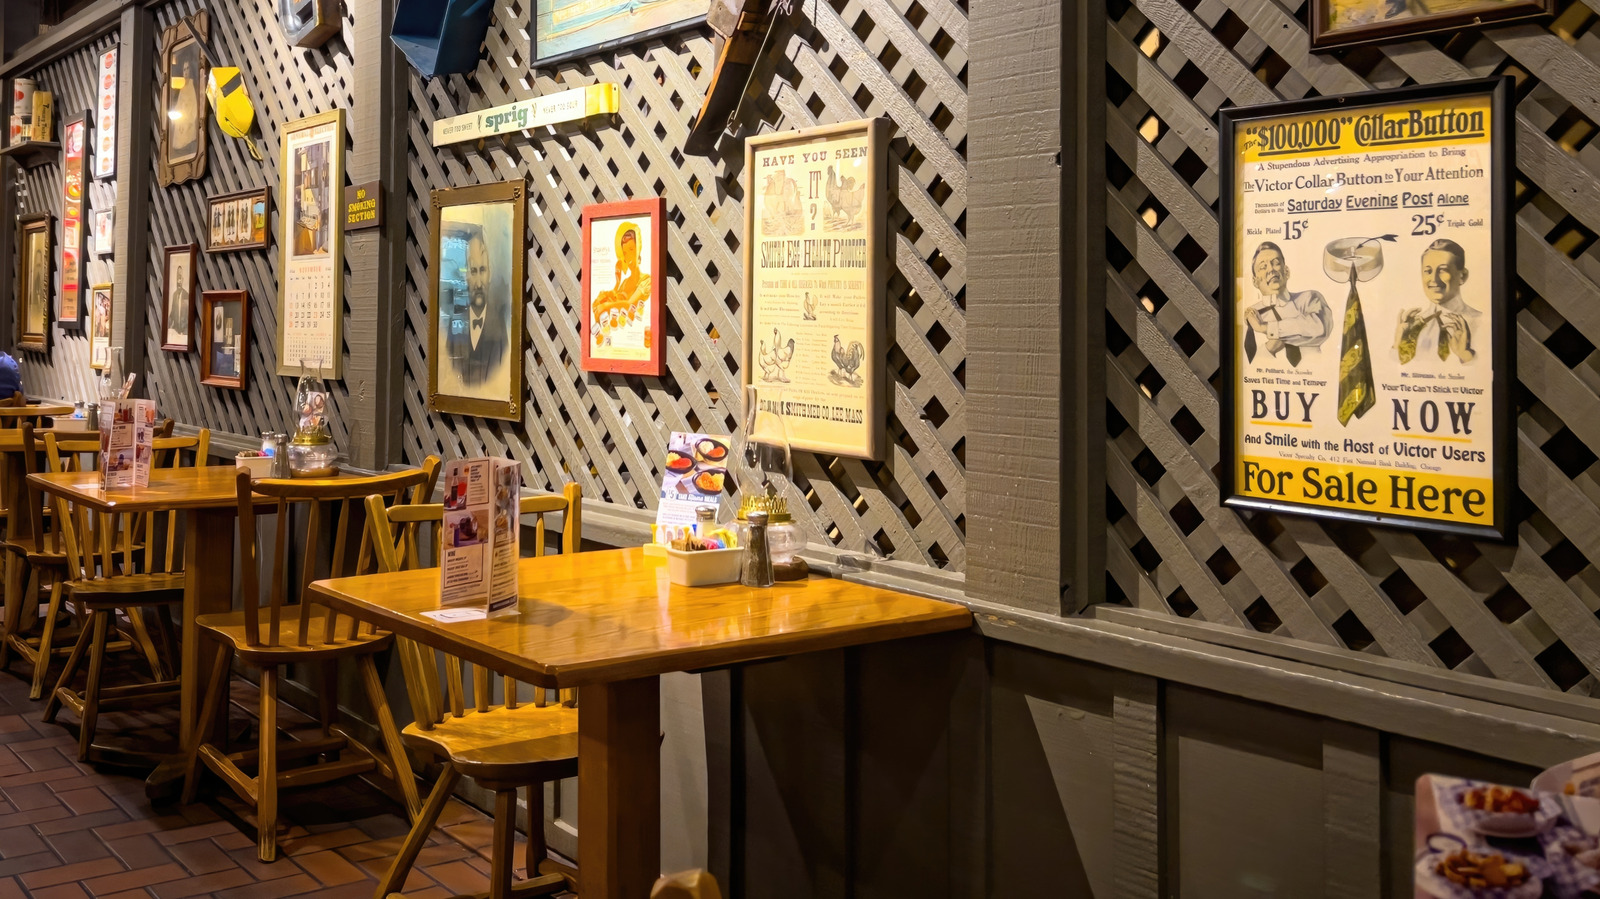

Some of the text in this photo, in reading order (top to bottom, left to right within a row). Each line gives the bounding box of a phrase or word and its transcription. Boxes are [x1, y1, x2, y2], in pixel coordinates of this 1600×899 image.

[485, 106, 528, 132] sprig
[1354, 114, 1408, 146] Collar
[1408, 108, 1484, 136] Button
[762, 146, 868, 167] HAVE YOU SEEN
[1258, 163, 1264, 171] A
[1267, 160, 1310, 171] Stupendous
[1314, 156, 1360, 166] Advertising
[1364, 150, 1426, 163] Appropriation
[1442, 147, 1466, 157] Bring
[808, 170, 822, 200] IT
[1244, 181, 1254, 190] The
[1254, 178, 1293, 192] Victor
[1295, 174, 1334, 189] Collar
[1336, 172, 1382, 186] Button
[1394, 168, 1424, 182] Your
[1425, 165, 1484, 180] Attention
[348, 198, 376, 213] SMOKING
[356, 189, 366, 199] NO
[1288, 192, 1469, 212] Saturday Evening Post Alone
[348, 210, 376, 223] SECTION
[810, 203, 818, 230] ?
[1302, 379, 1327, 387] Temper
[1382, 384, 1400, 392] Your
[1460, 386, 1484, 395] Victor
[1251, 390, 1319, 422] BUY
[1391, 398, 1476, 435] NOW
[1245, 432, 1486, 462] And Smile with the Host of Victor Users
[1243, 460, 1486, 517] For Sale Here
